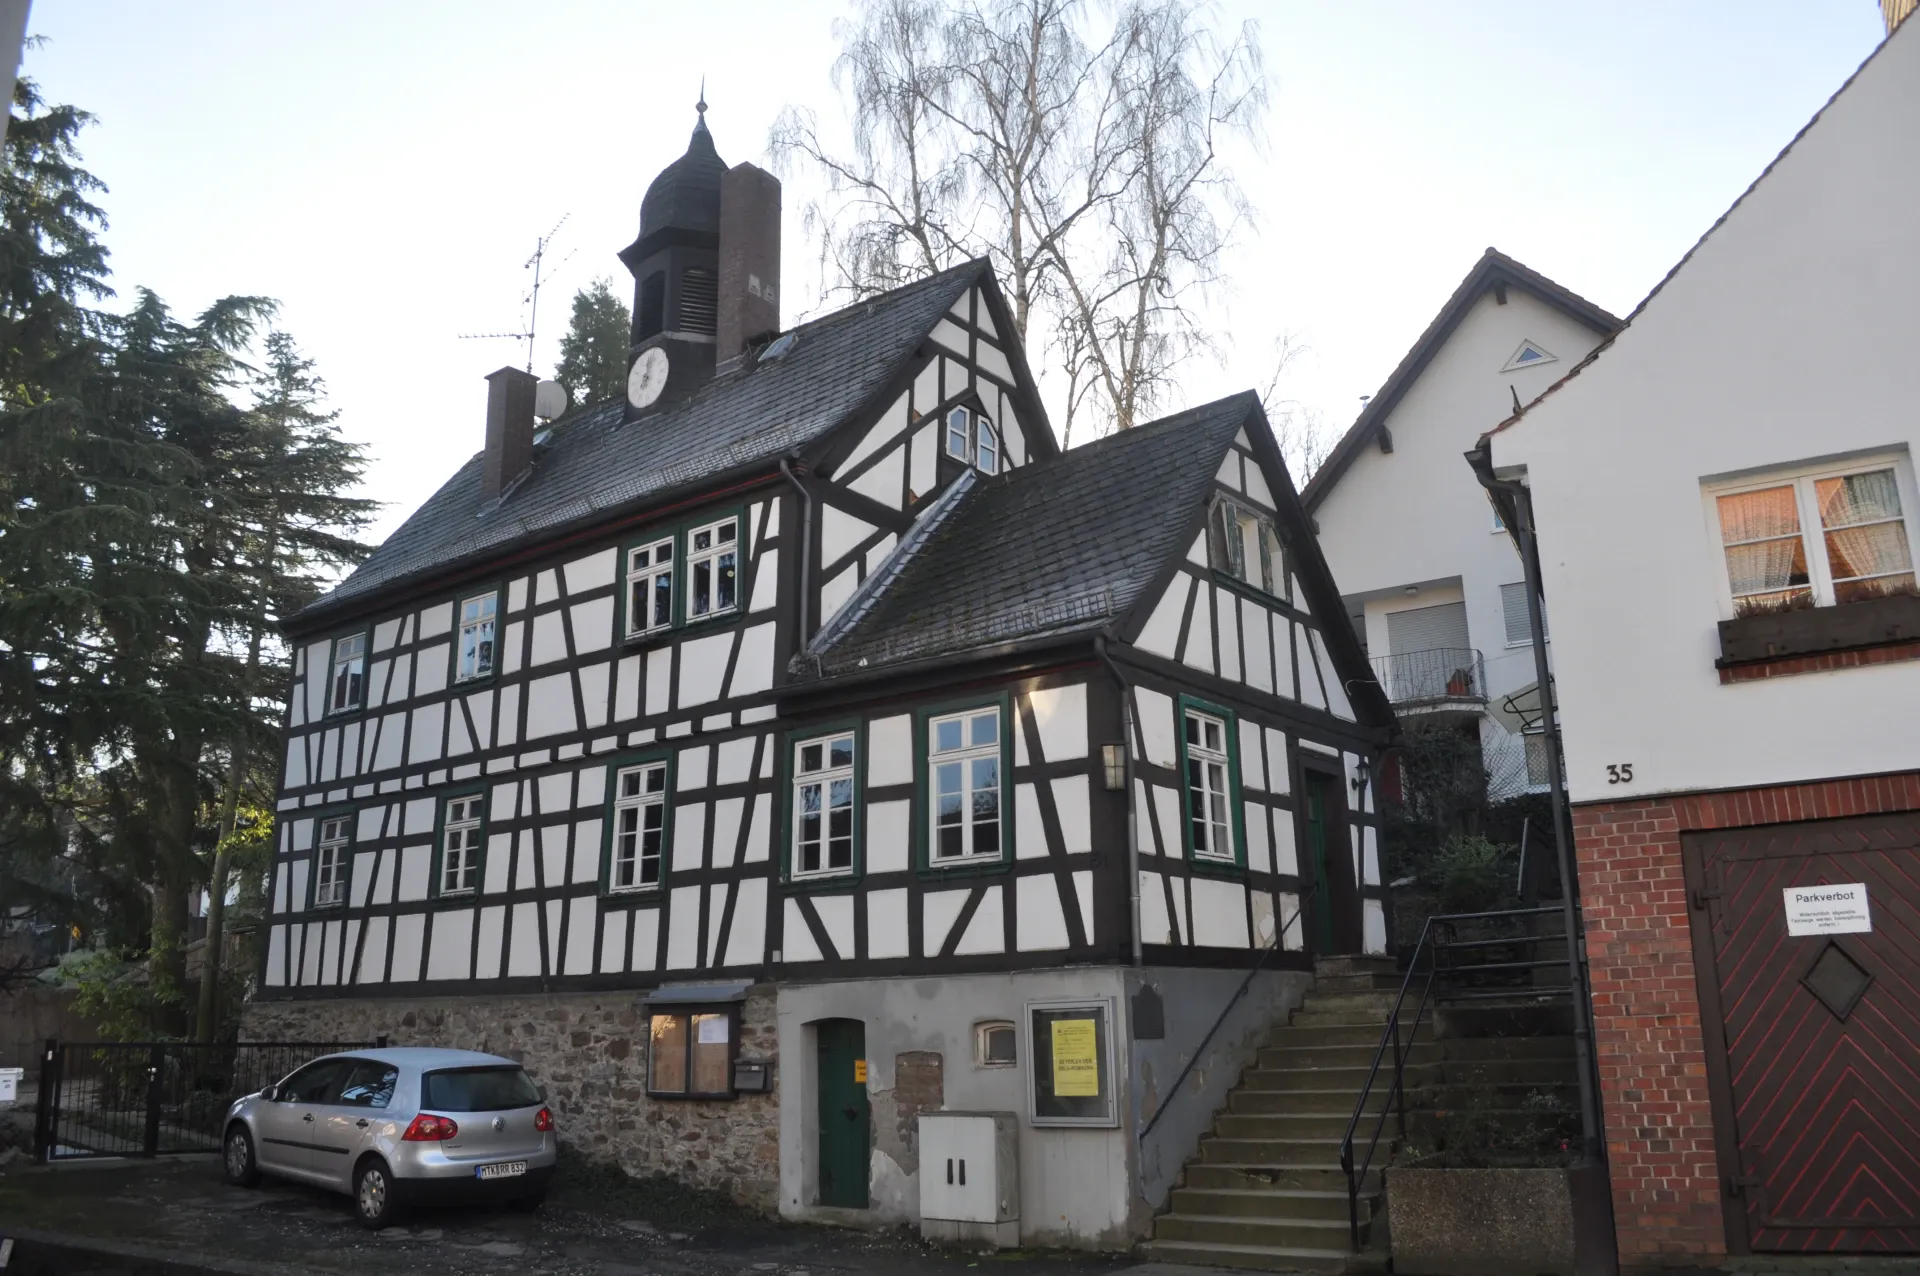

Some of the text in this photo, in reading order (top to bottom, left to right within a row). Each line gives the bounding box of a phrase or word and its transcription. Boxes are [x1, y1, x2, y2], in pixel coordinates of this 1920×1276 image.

[1606, 763, 1633, 784] 35
[1795, 891, 1855, 903] Parkverbot
[481, 1163, 524, 1176] MTK RR 832
